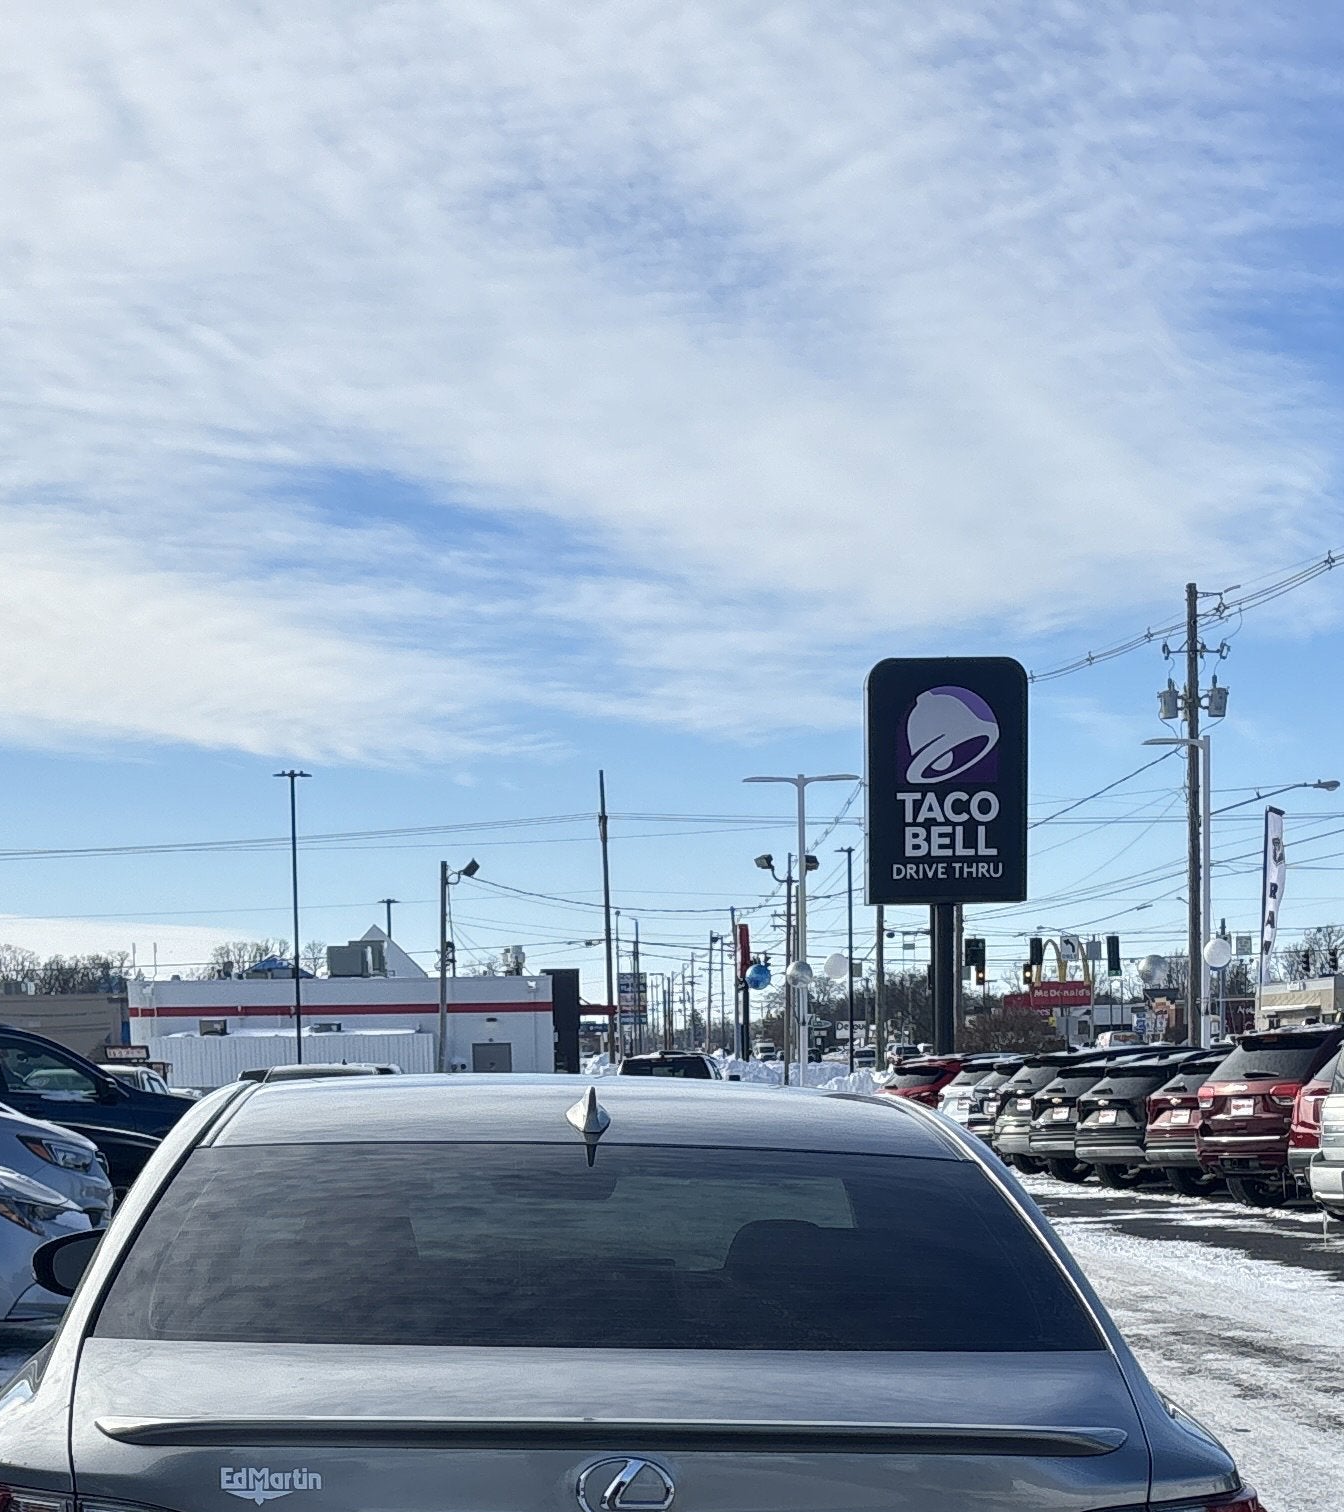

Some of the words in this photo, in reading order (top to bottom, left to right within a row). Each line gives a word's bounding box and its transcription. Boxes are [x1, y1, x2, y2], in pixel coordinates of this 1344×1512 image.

[897, 791, 1000, 823] TACO
[905, 826, 998, 857] BELL
[892, 863, 948, 880] DRIVE
[952, 862, 1003, 879] THRU
[220, 1467, 322, 1491] EdMartin
